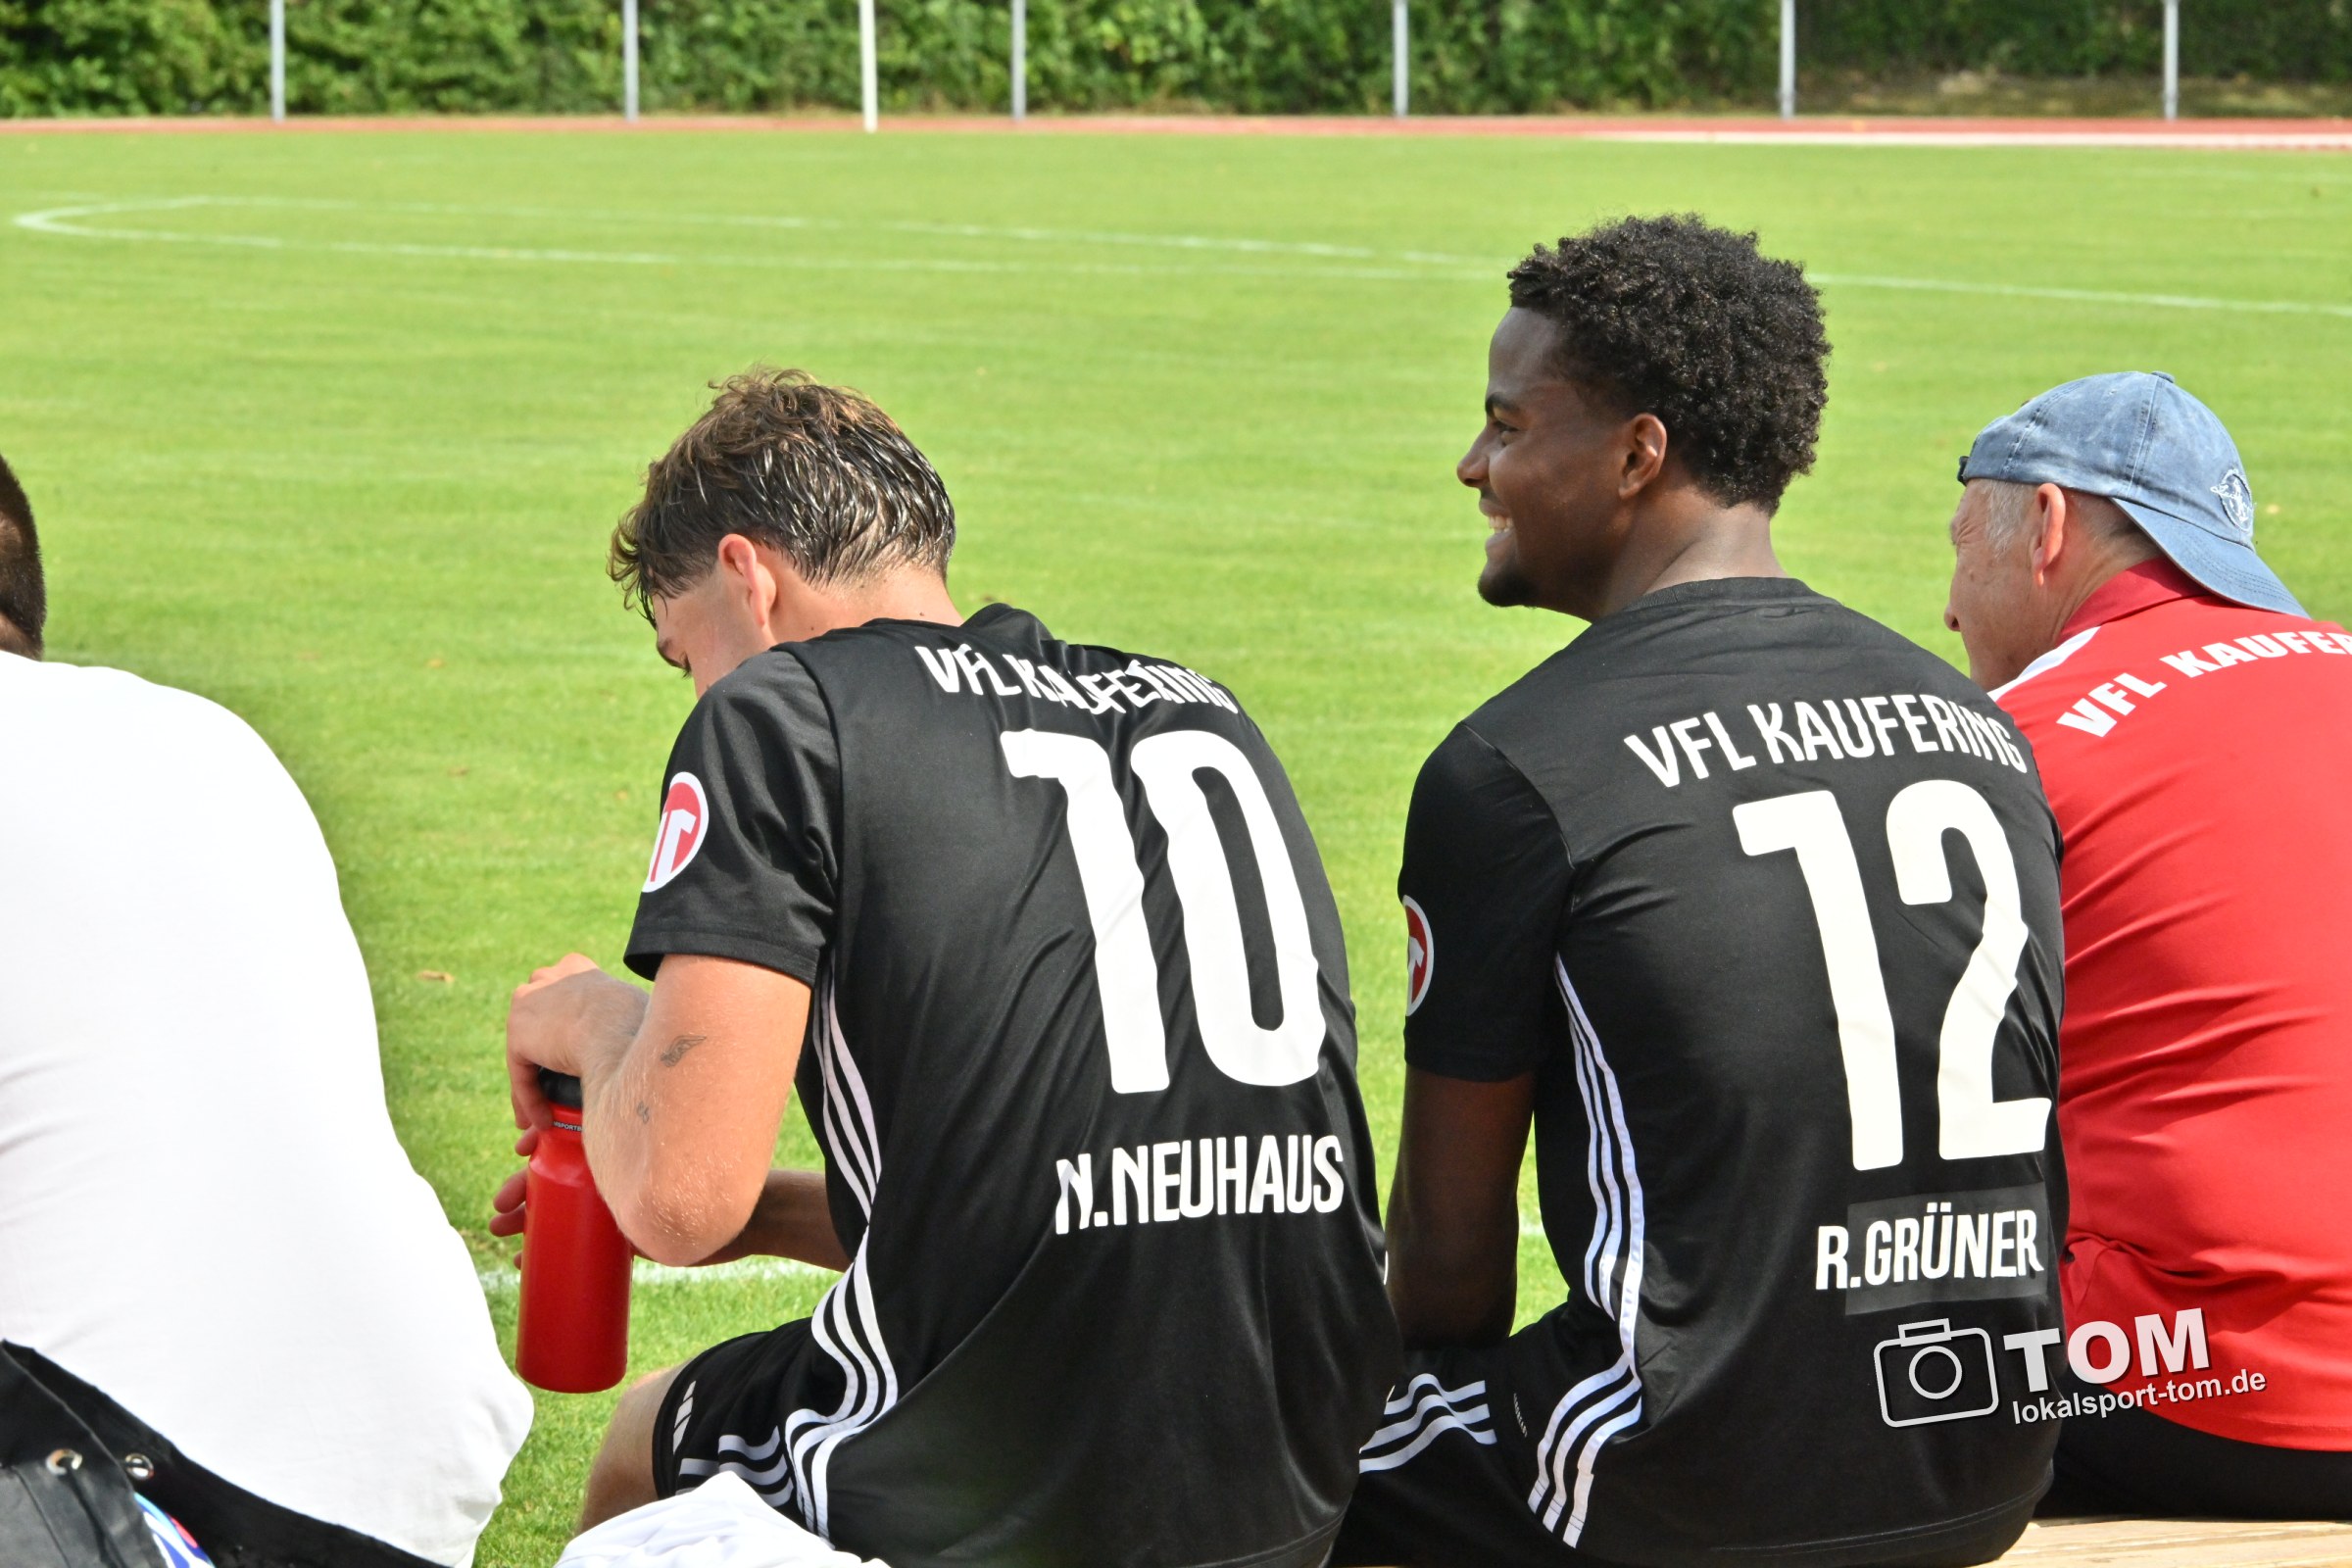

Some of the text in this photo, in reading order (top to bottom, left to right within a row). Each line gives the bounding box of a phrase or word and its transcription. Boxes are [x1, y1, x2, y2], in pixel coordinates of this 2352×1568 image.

[914, 643, 1022, 696] VFL
[2056, 672, 2168, 737] VFL
[1624, 694, 2028, 787] VFL KAUFERING
[1000, 728, 1326, 1094] 10
[1733, 779, 2052, 1171] 12
[1055, 1135, 1344, 1235] N.NEUHAUS
[1816, 1201, 2044, 1291] R.GRÜNER
